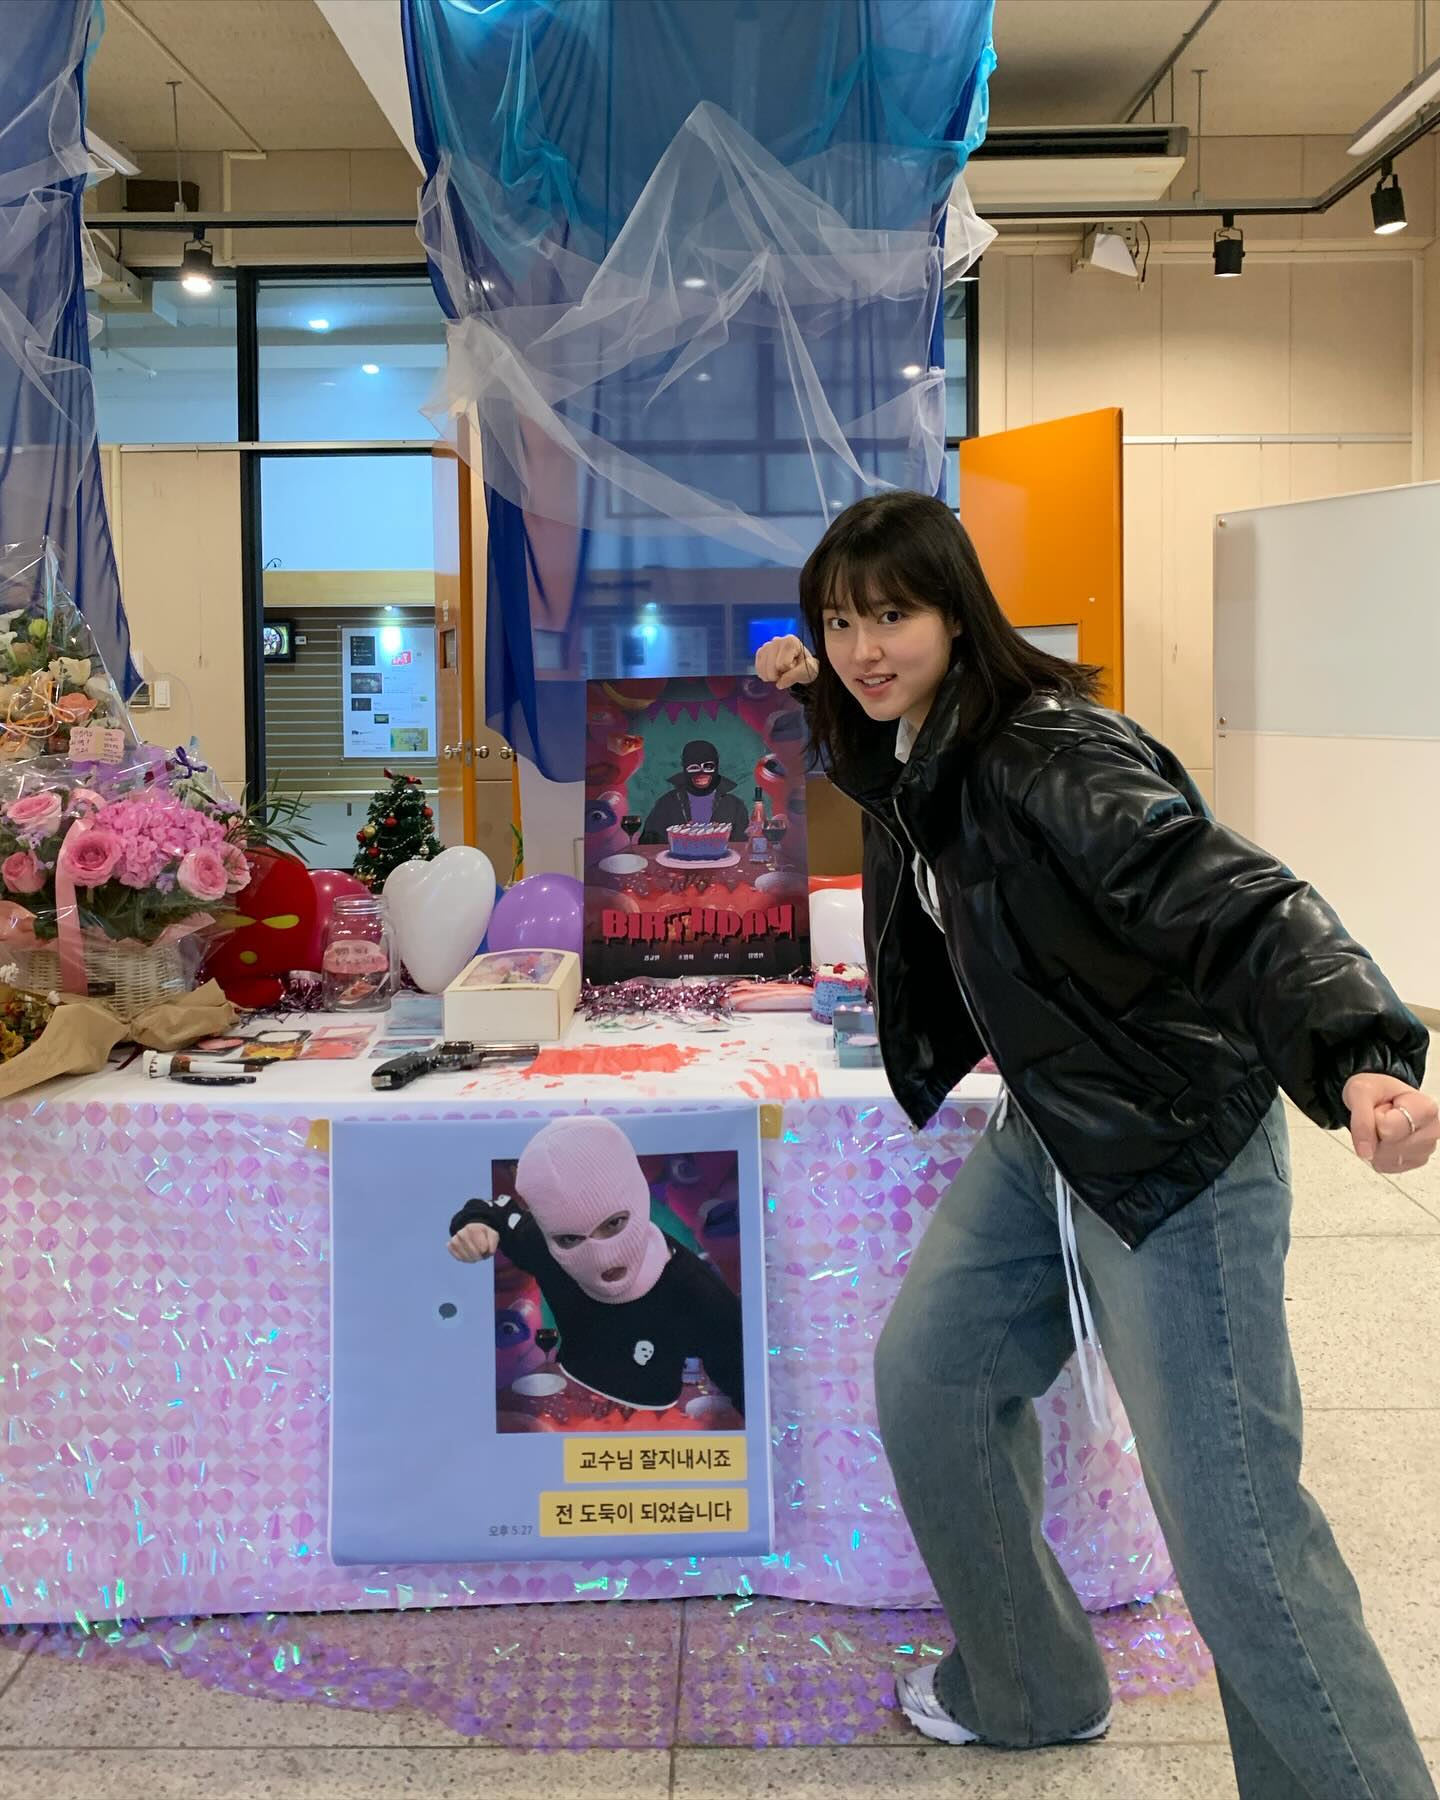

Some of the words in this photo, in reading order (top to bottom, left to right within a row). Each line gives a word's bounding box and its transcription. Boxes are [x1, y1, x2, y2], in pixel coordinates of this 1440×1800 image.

[602, 904, 795, 945] BIRTHDAY
[579, 1449, 634, 1471] 교수님
[640, 1448, 732, 1470] 잘지내시죠
[556, 1504, 573, 1526] 전
[579, 1502, 634, 1525] 도둑이
[641, 1500, 732, 1523] 되었습니다
[488, 1525, 509, 1537] 오후
